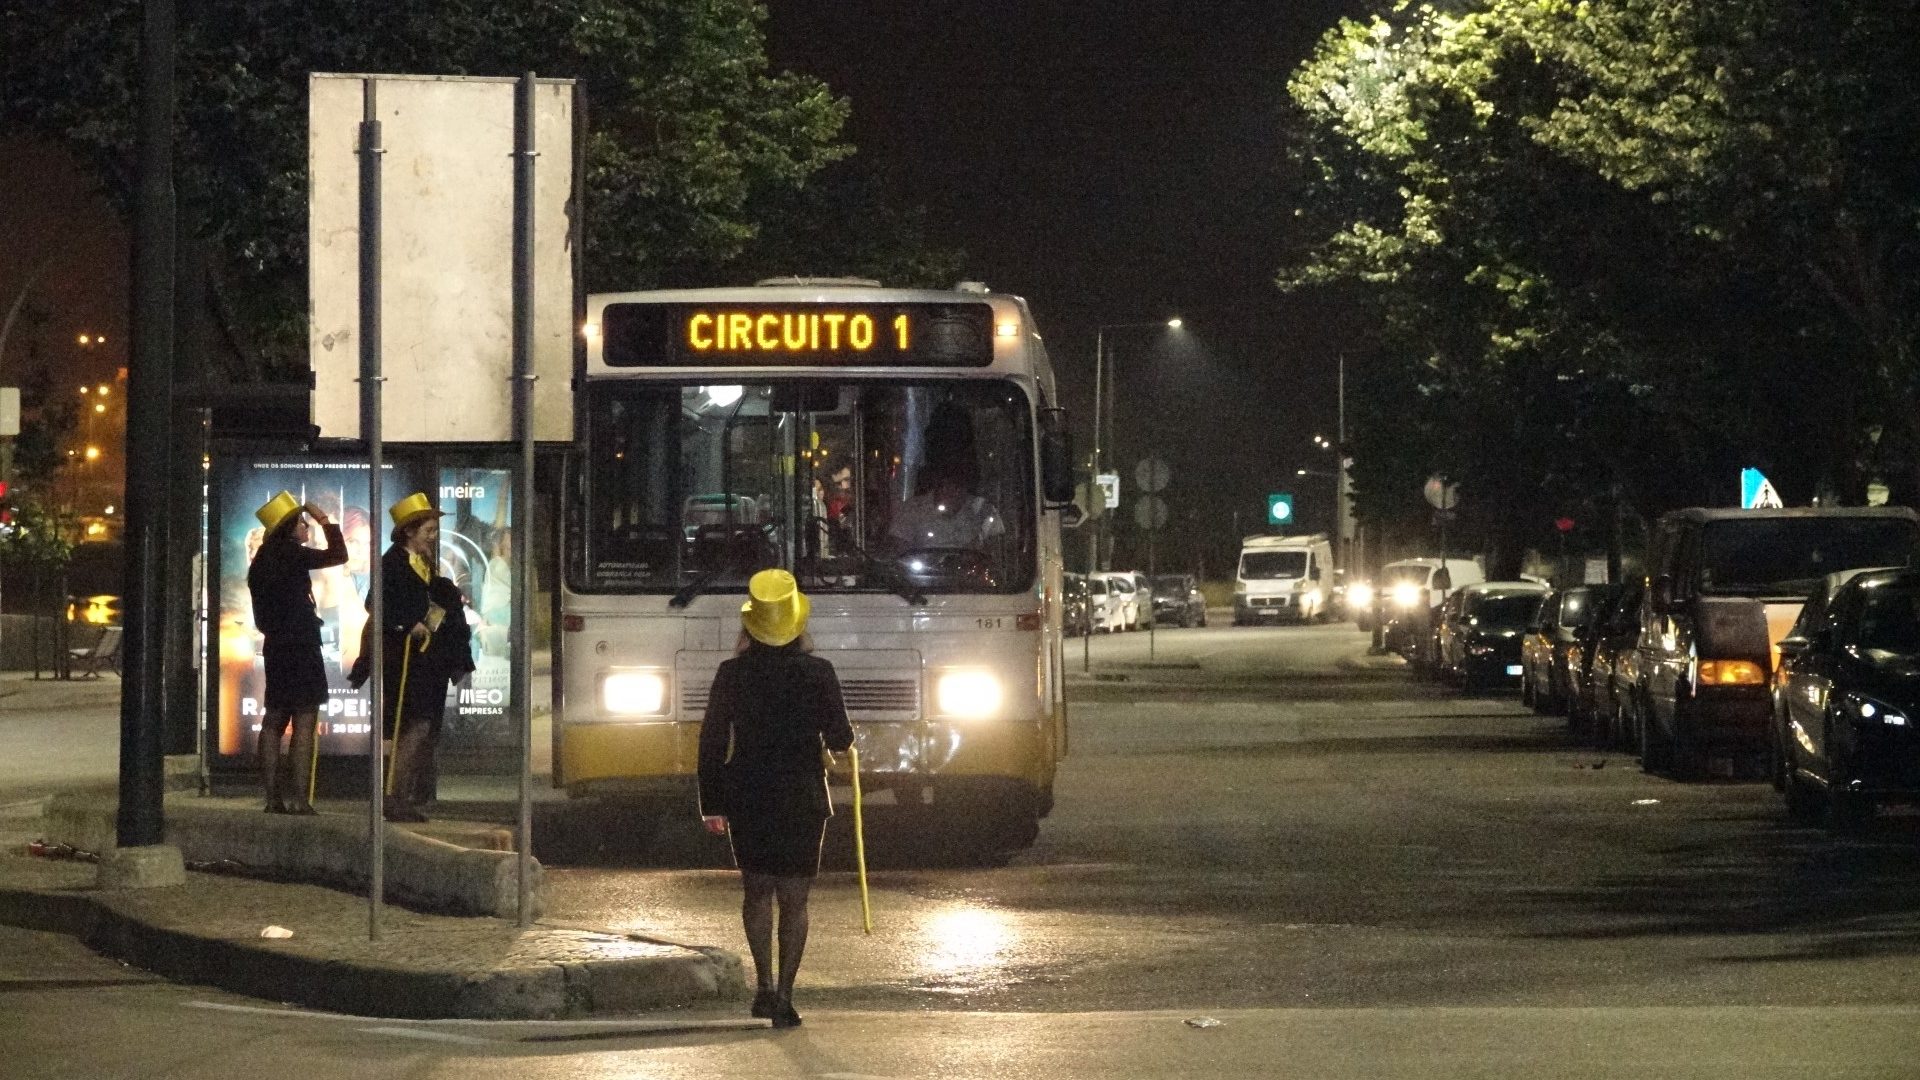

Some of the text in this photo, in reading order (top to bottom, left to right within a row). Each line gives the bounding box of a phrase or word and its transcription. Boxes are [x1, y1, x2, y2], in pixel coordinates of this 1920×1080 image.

[690, 314, 908, 350] CIRCUITO 1
[976, 618, 1001, 629] 181
[459, 688, 503, 705] MEO
[459, 706, 503, 715] EMPRESAS
